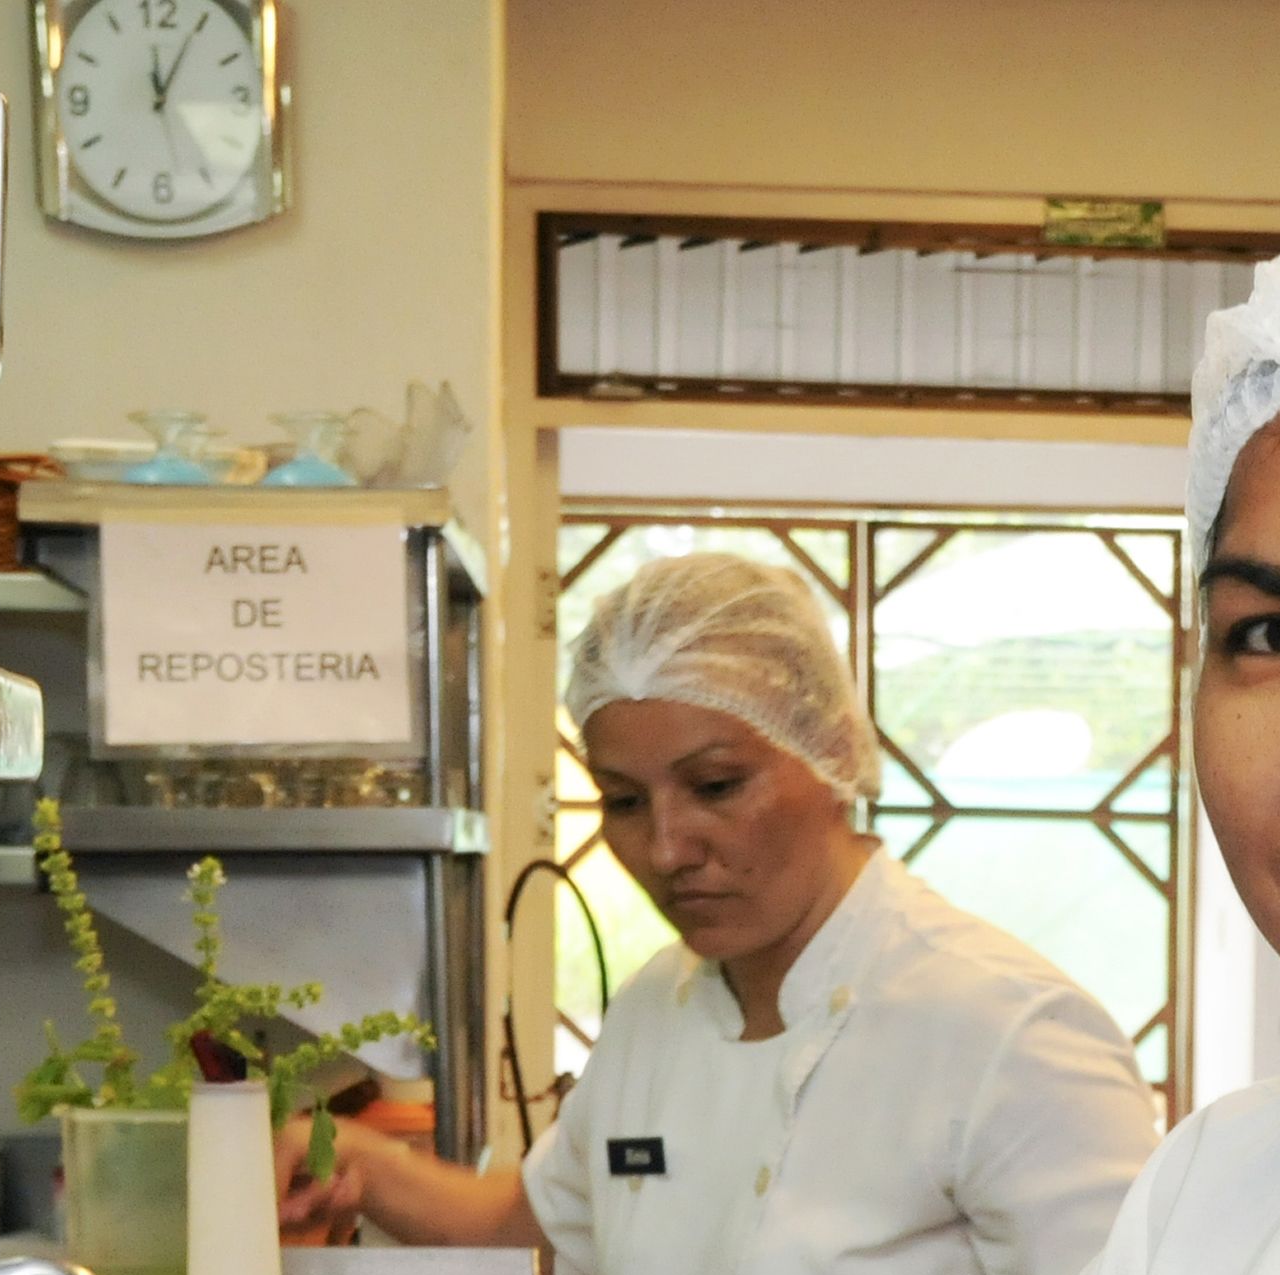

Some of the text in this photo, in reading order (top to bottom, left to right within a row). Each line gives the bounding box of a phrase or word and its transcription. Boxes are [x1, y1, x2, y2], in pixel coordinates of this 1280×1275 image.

[139, 0, 178, 29] 12
[70, 84, 90, 117] 9
[231, 84, 252, 116] 3
[152, 172, 174, 204] 6
[204, 545, 308, 574] AREA
[232, 599, 284, 629] DE
[137, 653, 381, 682] REPOSTERIA
